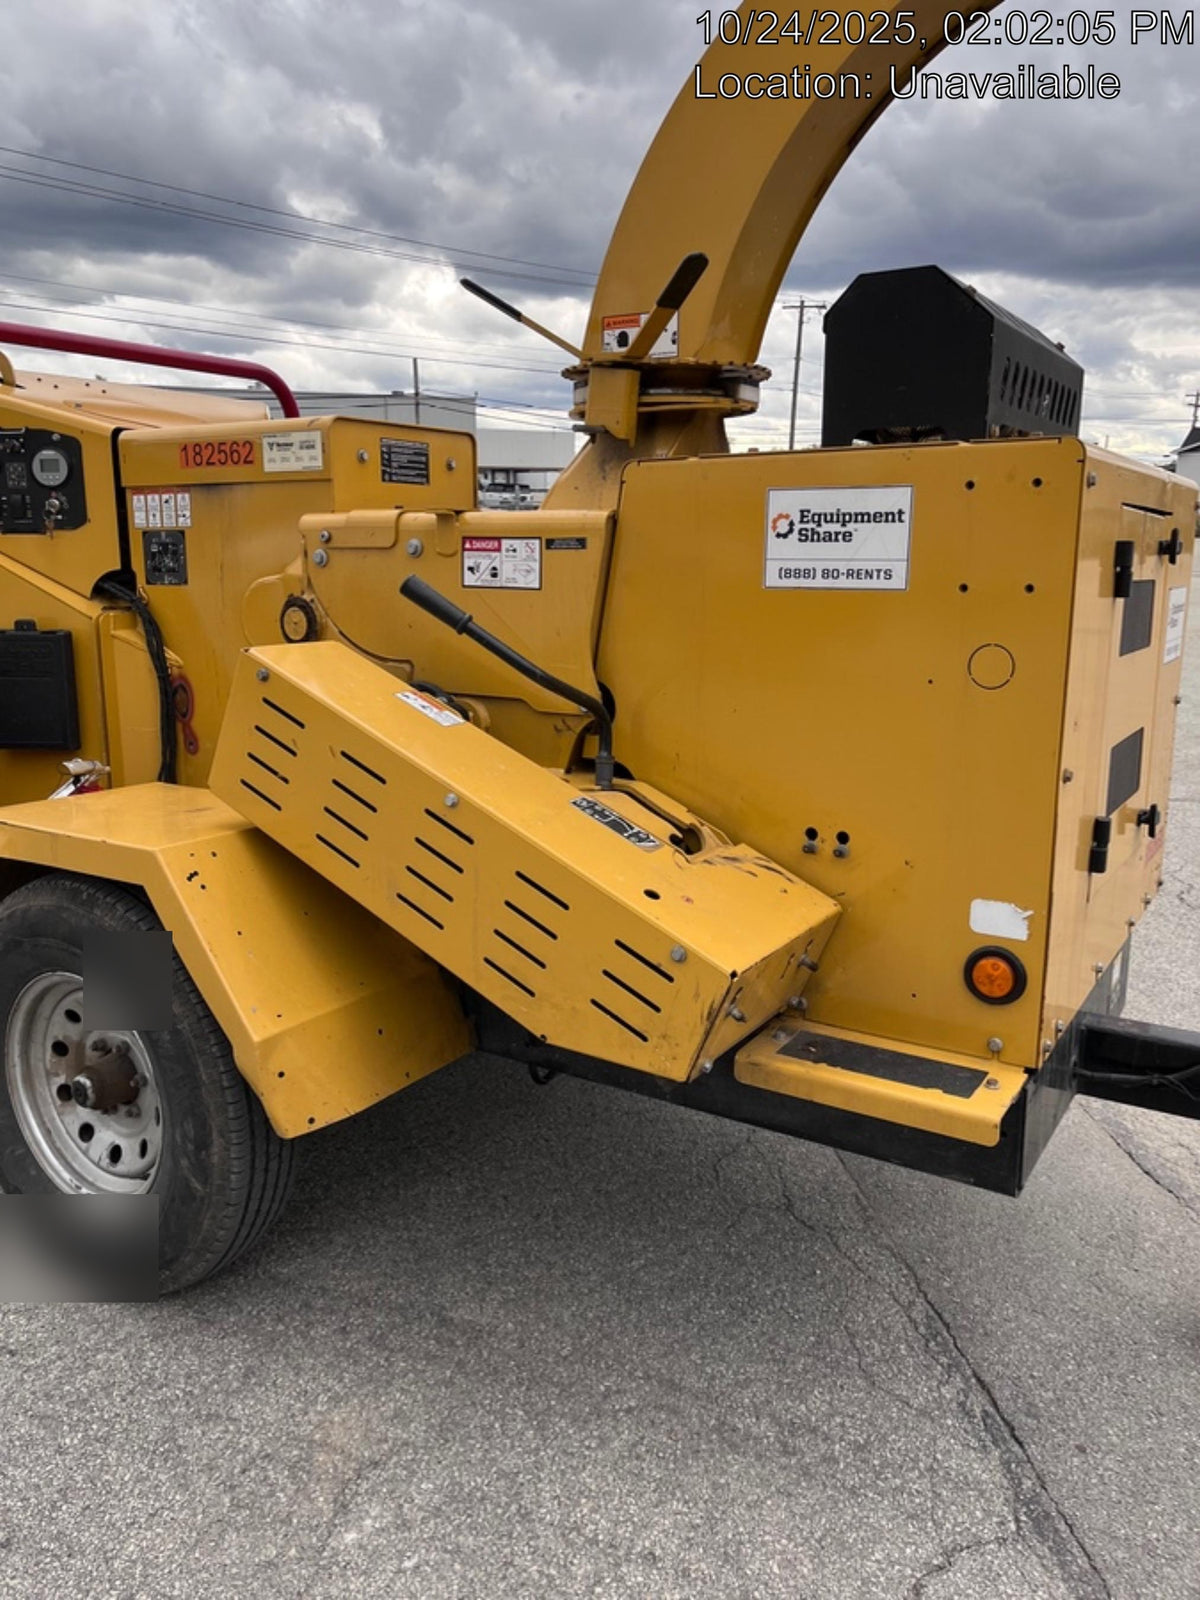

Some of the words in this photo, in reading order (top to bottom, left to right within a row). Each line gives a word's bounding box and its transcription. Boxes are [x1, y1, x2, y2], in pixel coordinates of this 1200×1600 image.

[180, 440, 254, 467] 182562
[798, 508, 905, 528] Equipment
[797, 527, 853, 543] Share
[778, 567, 817, 580] (888)
[821, 568, 893, 580] 80-RENTS
